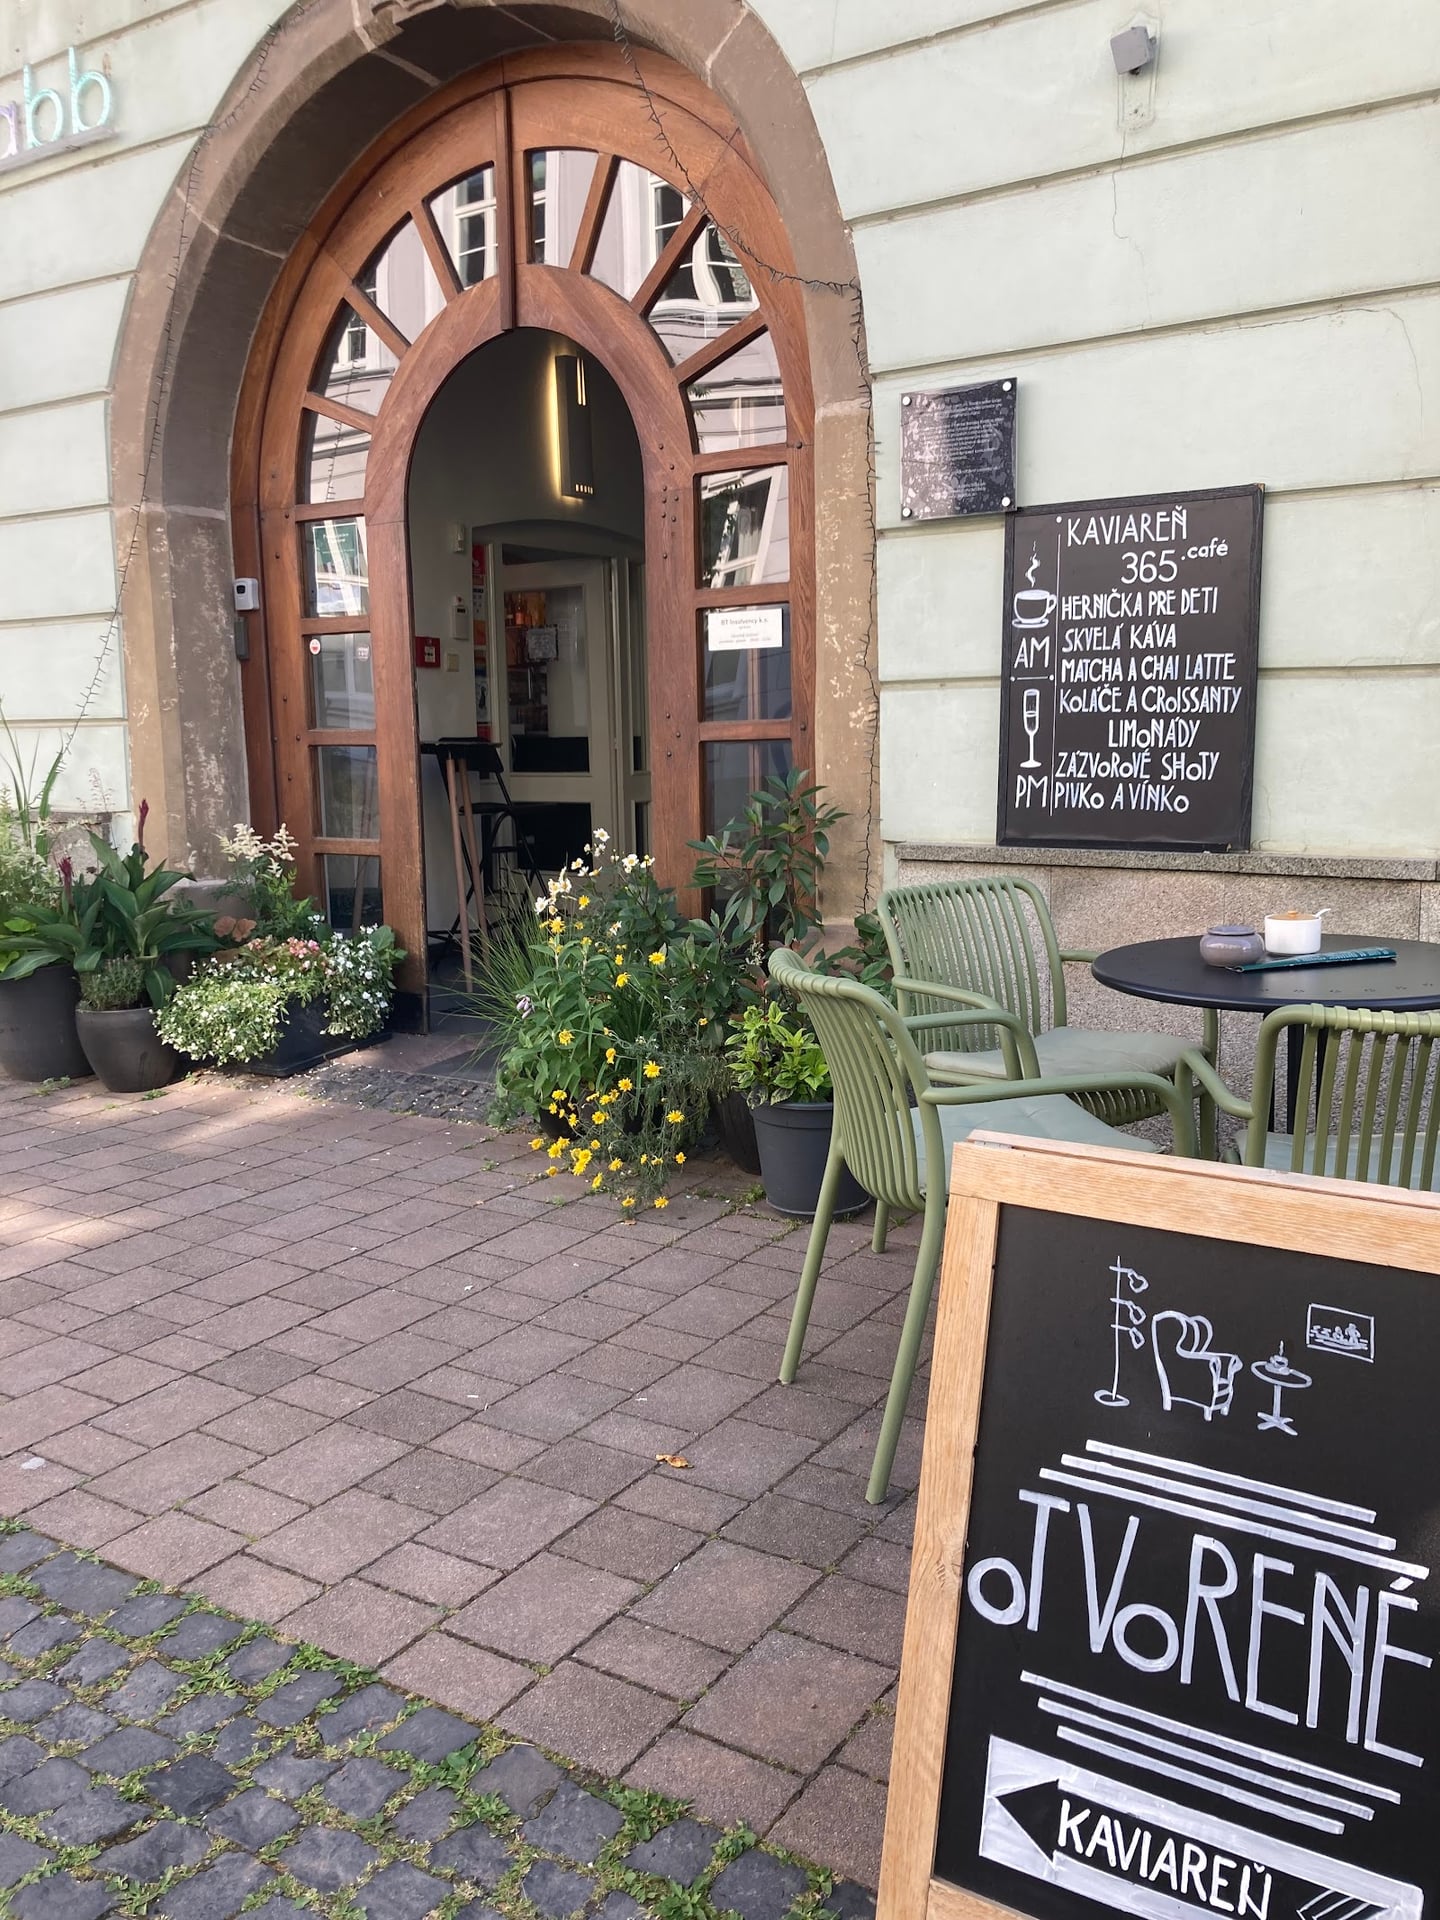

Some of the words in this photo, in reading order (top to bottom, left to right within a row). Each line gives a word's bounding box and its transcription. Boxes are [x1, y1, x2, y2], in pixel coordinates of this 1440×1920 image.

[1067, 504, 1187, 547] KAVIAREŇ
[1061, 588, 1143, 621] HERNIČKA
[1148, 589, 1177, 617] PRE
[1181, 586, 1218, 616] DETI
[1014, 635, 1050, 669] AM
[1062, 622, 1125, 653] SKVELÁ
[1130, 619, 1177, 649] KÁVA
[1061, 656, 1123, 683] MATCHA
[1127, 656, 1138, 682] A
[1141, 654, 1180, 681] CHAI
[1185, 652, 1237, 680] LATTE
[1126, 686, 1138, 713] A
[1015, 774, 1049, 809] PM
[1110, 782, 1125, 810] A
[1056, 1800, 1273, 1920] KAVIAREŇ
